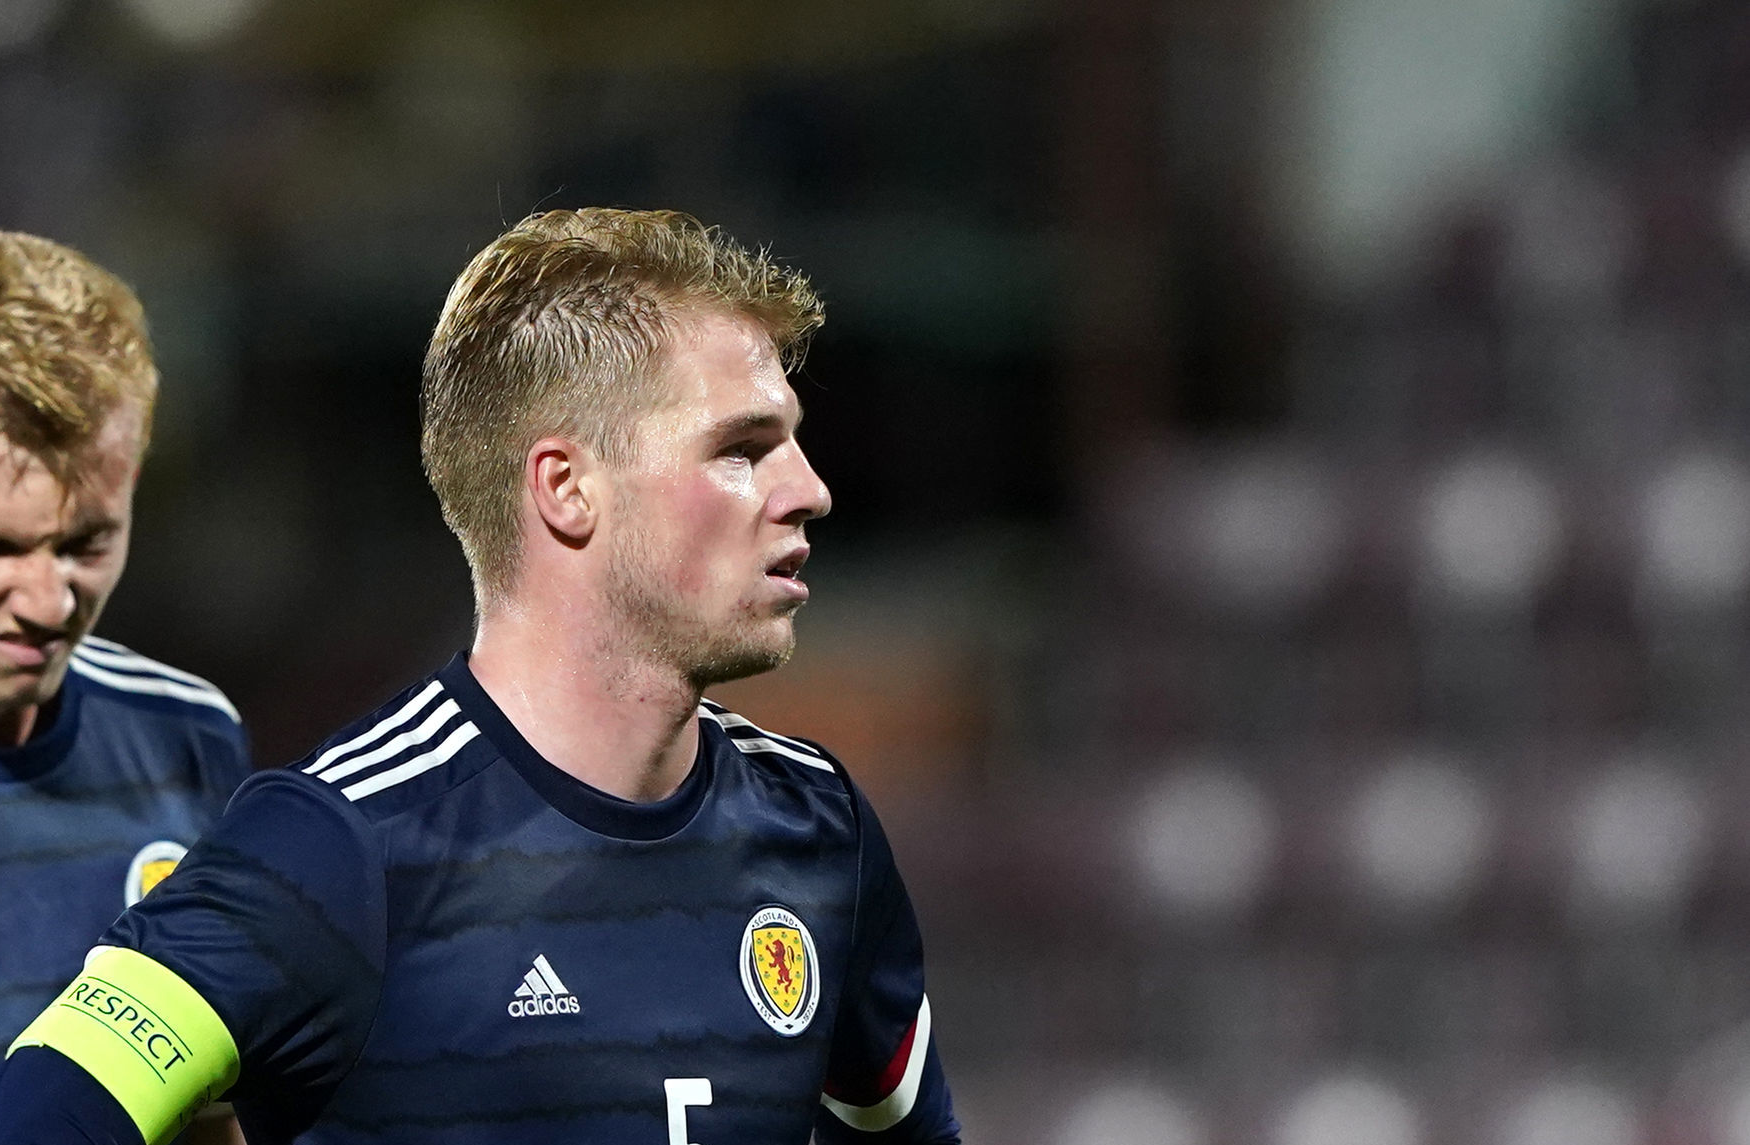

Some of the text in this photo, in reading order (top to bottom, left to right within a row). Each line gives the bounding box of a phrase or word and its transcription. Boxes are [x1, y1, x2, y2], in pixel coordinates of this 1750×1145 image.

[753, 911, 796, 928] SCOTLAND
[507, 993, 581, 1018] adidas
[67, 982, 186, 1071] RESPECT
